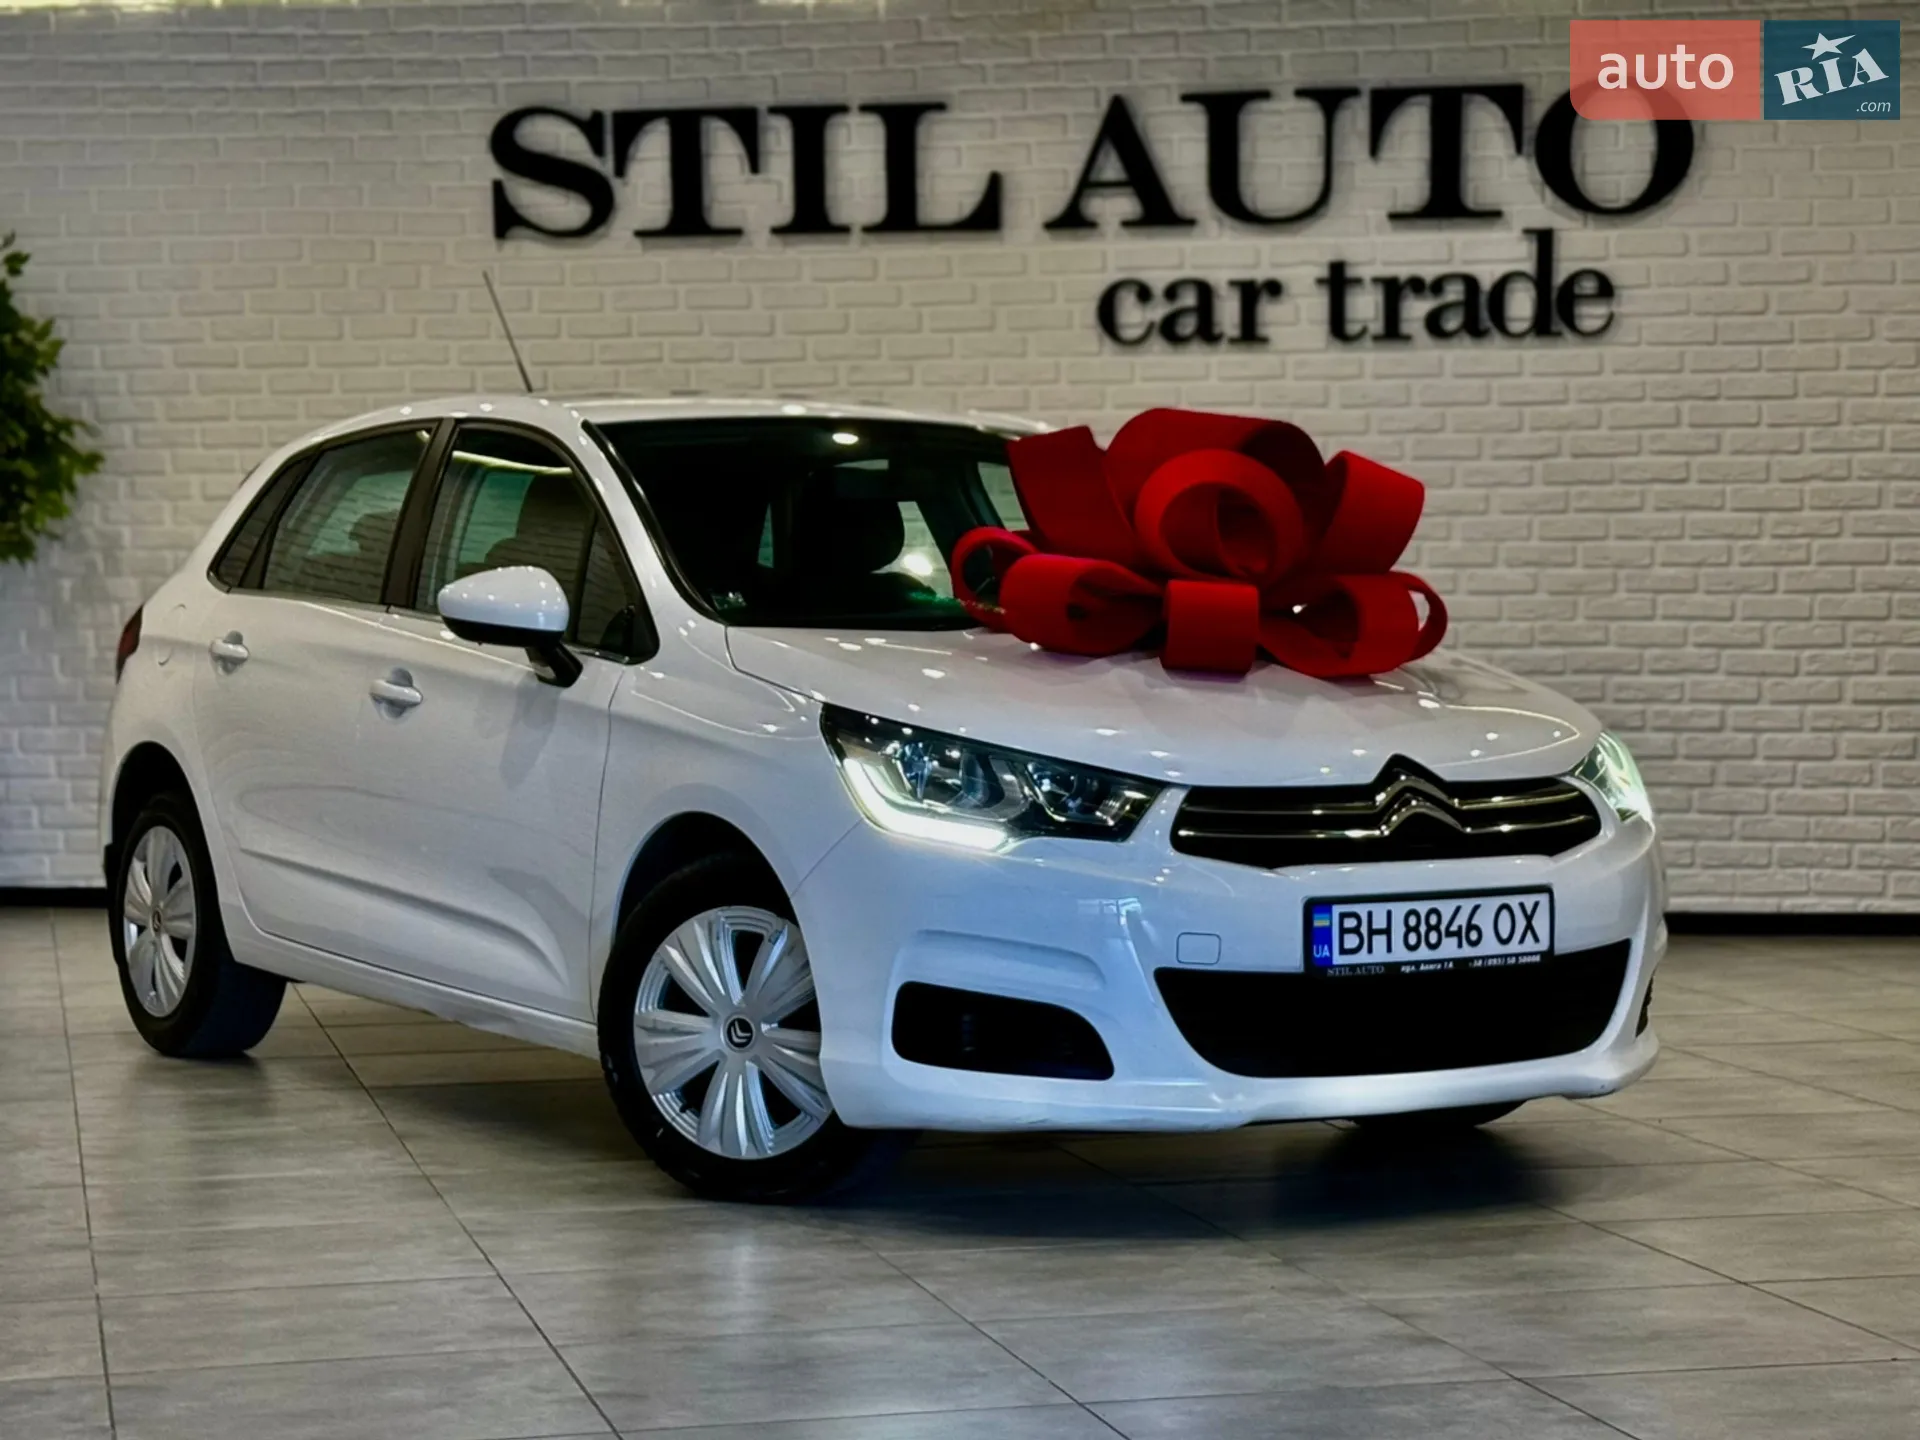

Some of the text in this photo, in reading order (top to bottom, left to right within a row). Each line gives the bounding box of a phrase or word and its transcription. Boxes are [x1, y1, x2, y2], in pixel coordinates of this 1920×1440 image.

[489, 75, 1695, 241] STIL AUTO
[1097, 227, 1616, 346] car trade
[1313, 945, 1330, 959] UA
[1338, 900, 1541, 956] BH 8846 OX
